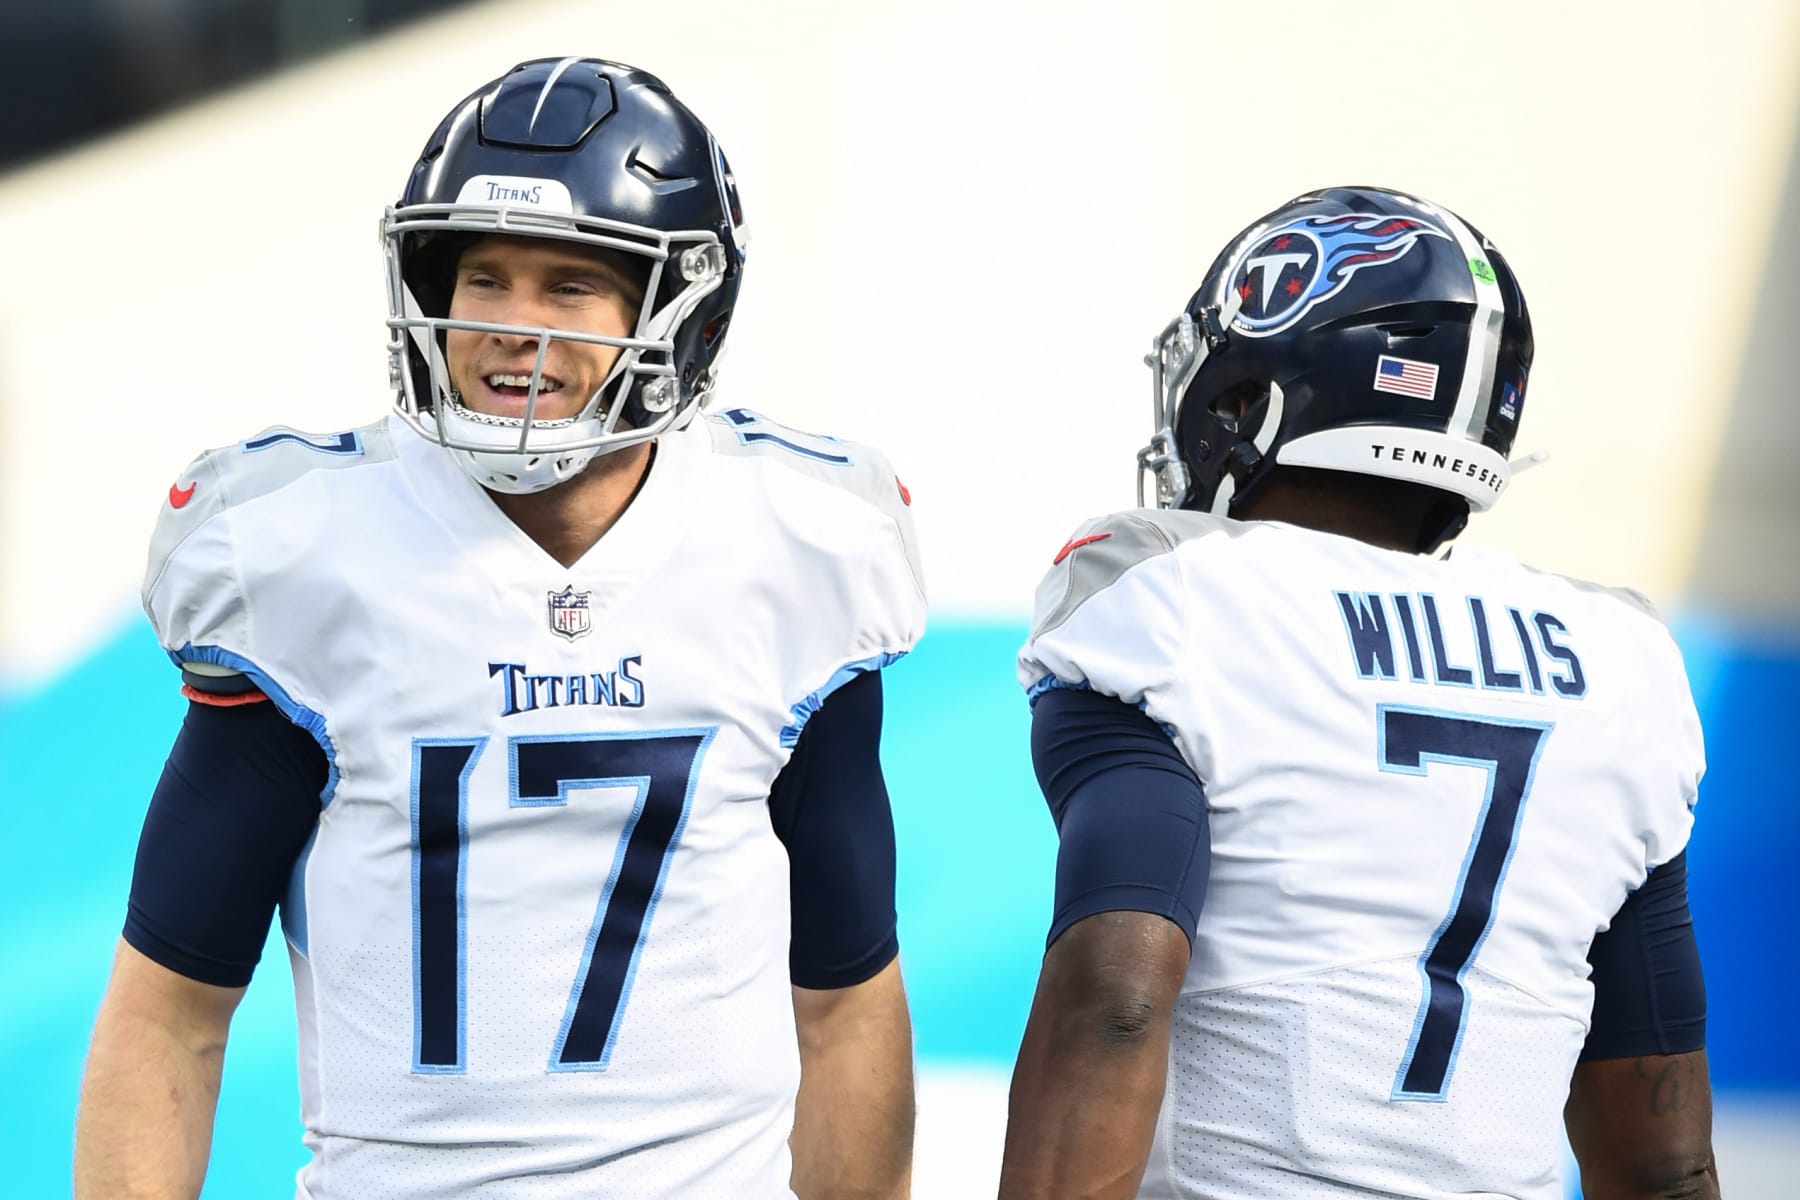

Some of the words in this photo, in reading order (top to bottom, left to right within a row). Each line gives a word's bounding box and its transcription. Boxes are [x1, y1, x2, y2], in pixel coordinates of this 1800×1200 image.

[486, 181, 541, 204] TITANS
[557, 610, 587, 632] NFL
[1332, 589, 1589, 700] WILLIS
[488, 655, 645, 717] TITANS
[410, 725, 720, 1075] 17
[1376, 703, 1555, 1103] 7
